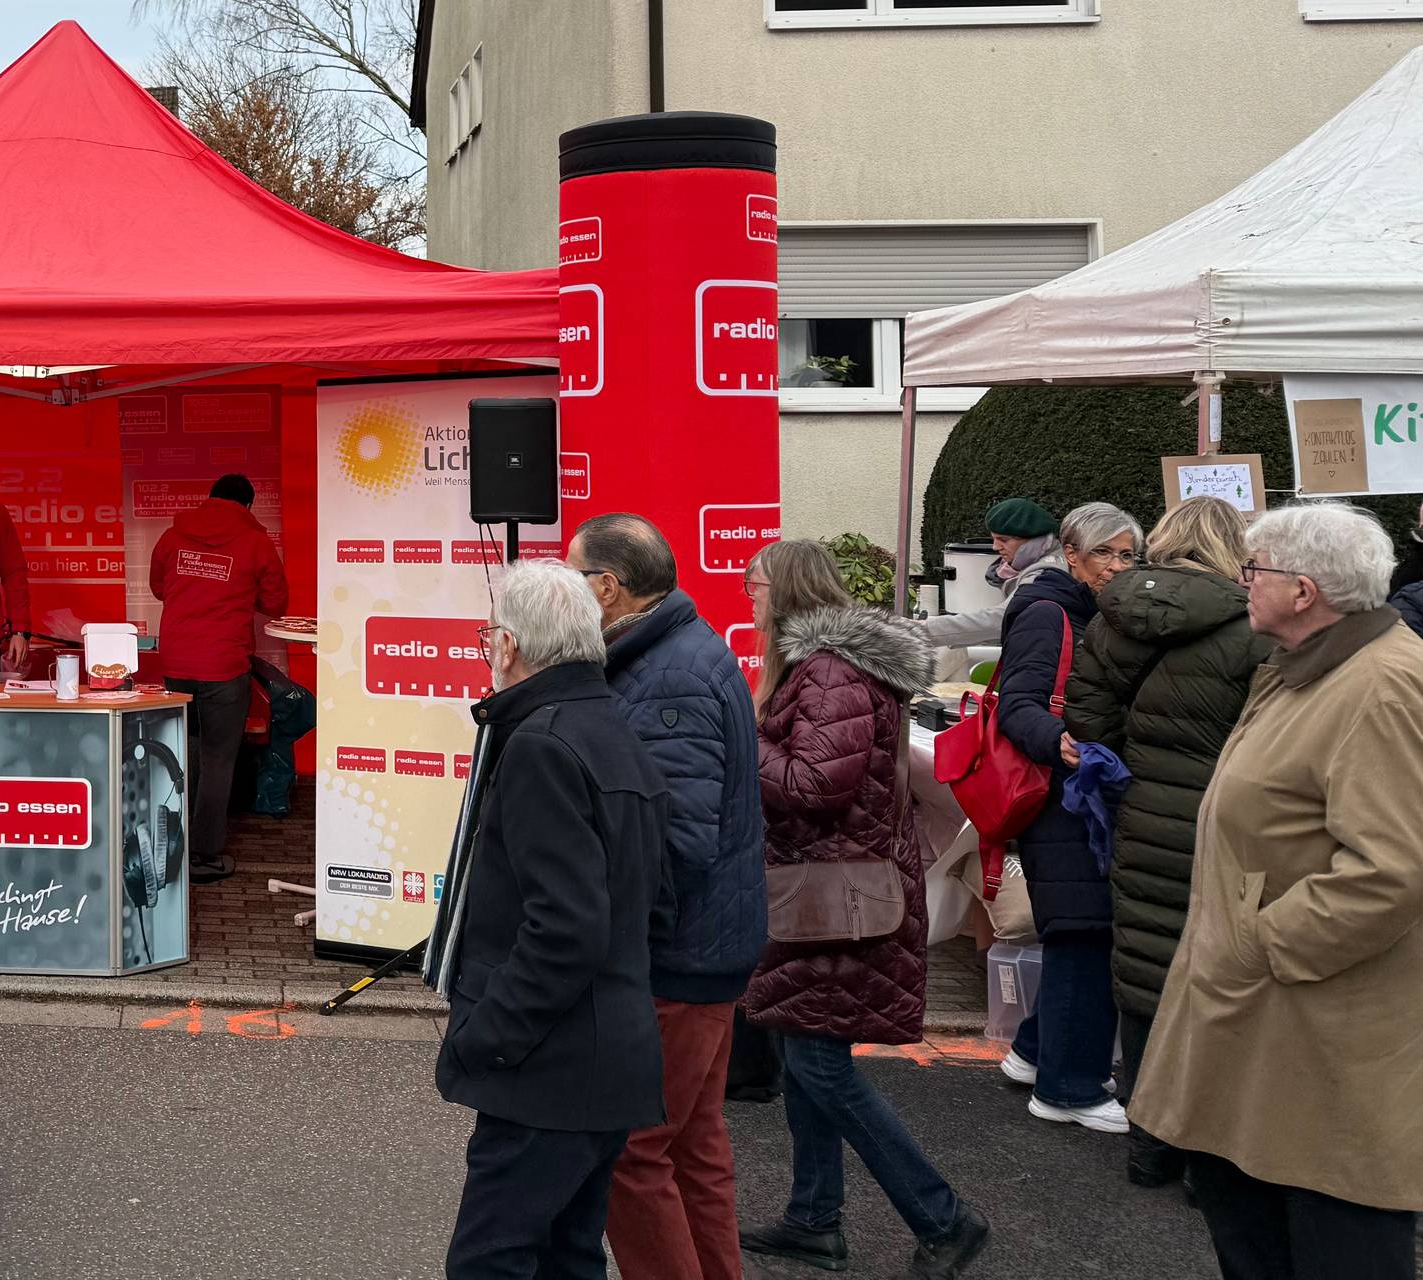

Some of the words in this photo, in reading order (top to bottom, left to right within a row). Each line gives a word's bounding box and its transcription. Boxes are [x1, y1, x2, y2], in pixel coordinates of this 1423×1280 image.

[751, 211, 771, 220] radio
[570, 232, 596, 243] essen
[559, 325, 590, 342] sen
[713, 318, 775, 340] radio
[1374, 403, 1423, 445] Ki
[1304, 430, 1356, 446] KONTAKTLOS
[425, 477, 442, 486] Weil
[144, 493, 175, 502] radio
[178, 494, 209, 502] esse
[5, 499, 85, 523] adio
[710, 526, 756, 540] radio
[57, 559, 90, 572] hier.
[373, 640, 438, 658] radio
[448, 646, 490, 660] ess
[17, 802, 81, 814] essen
[330, 868, 347, 877] NRW
